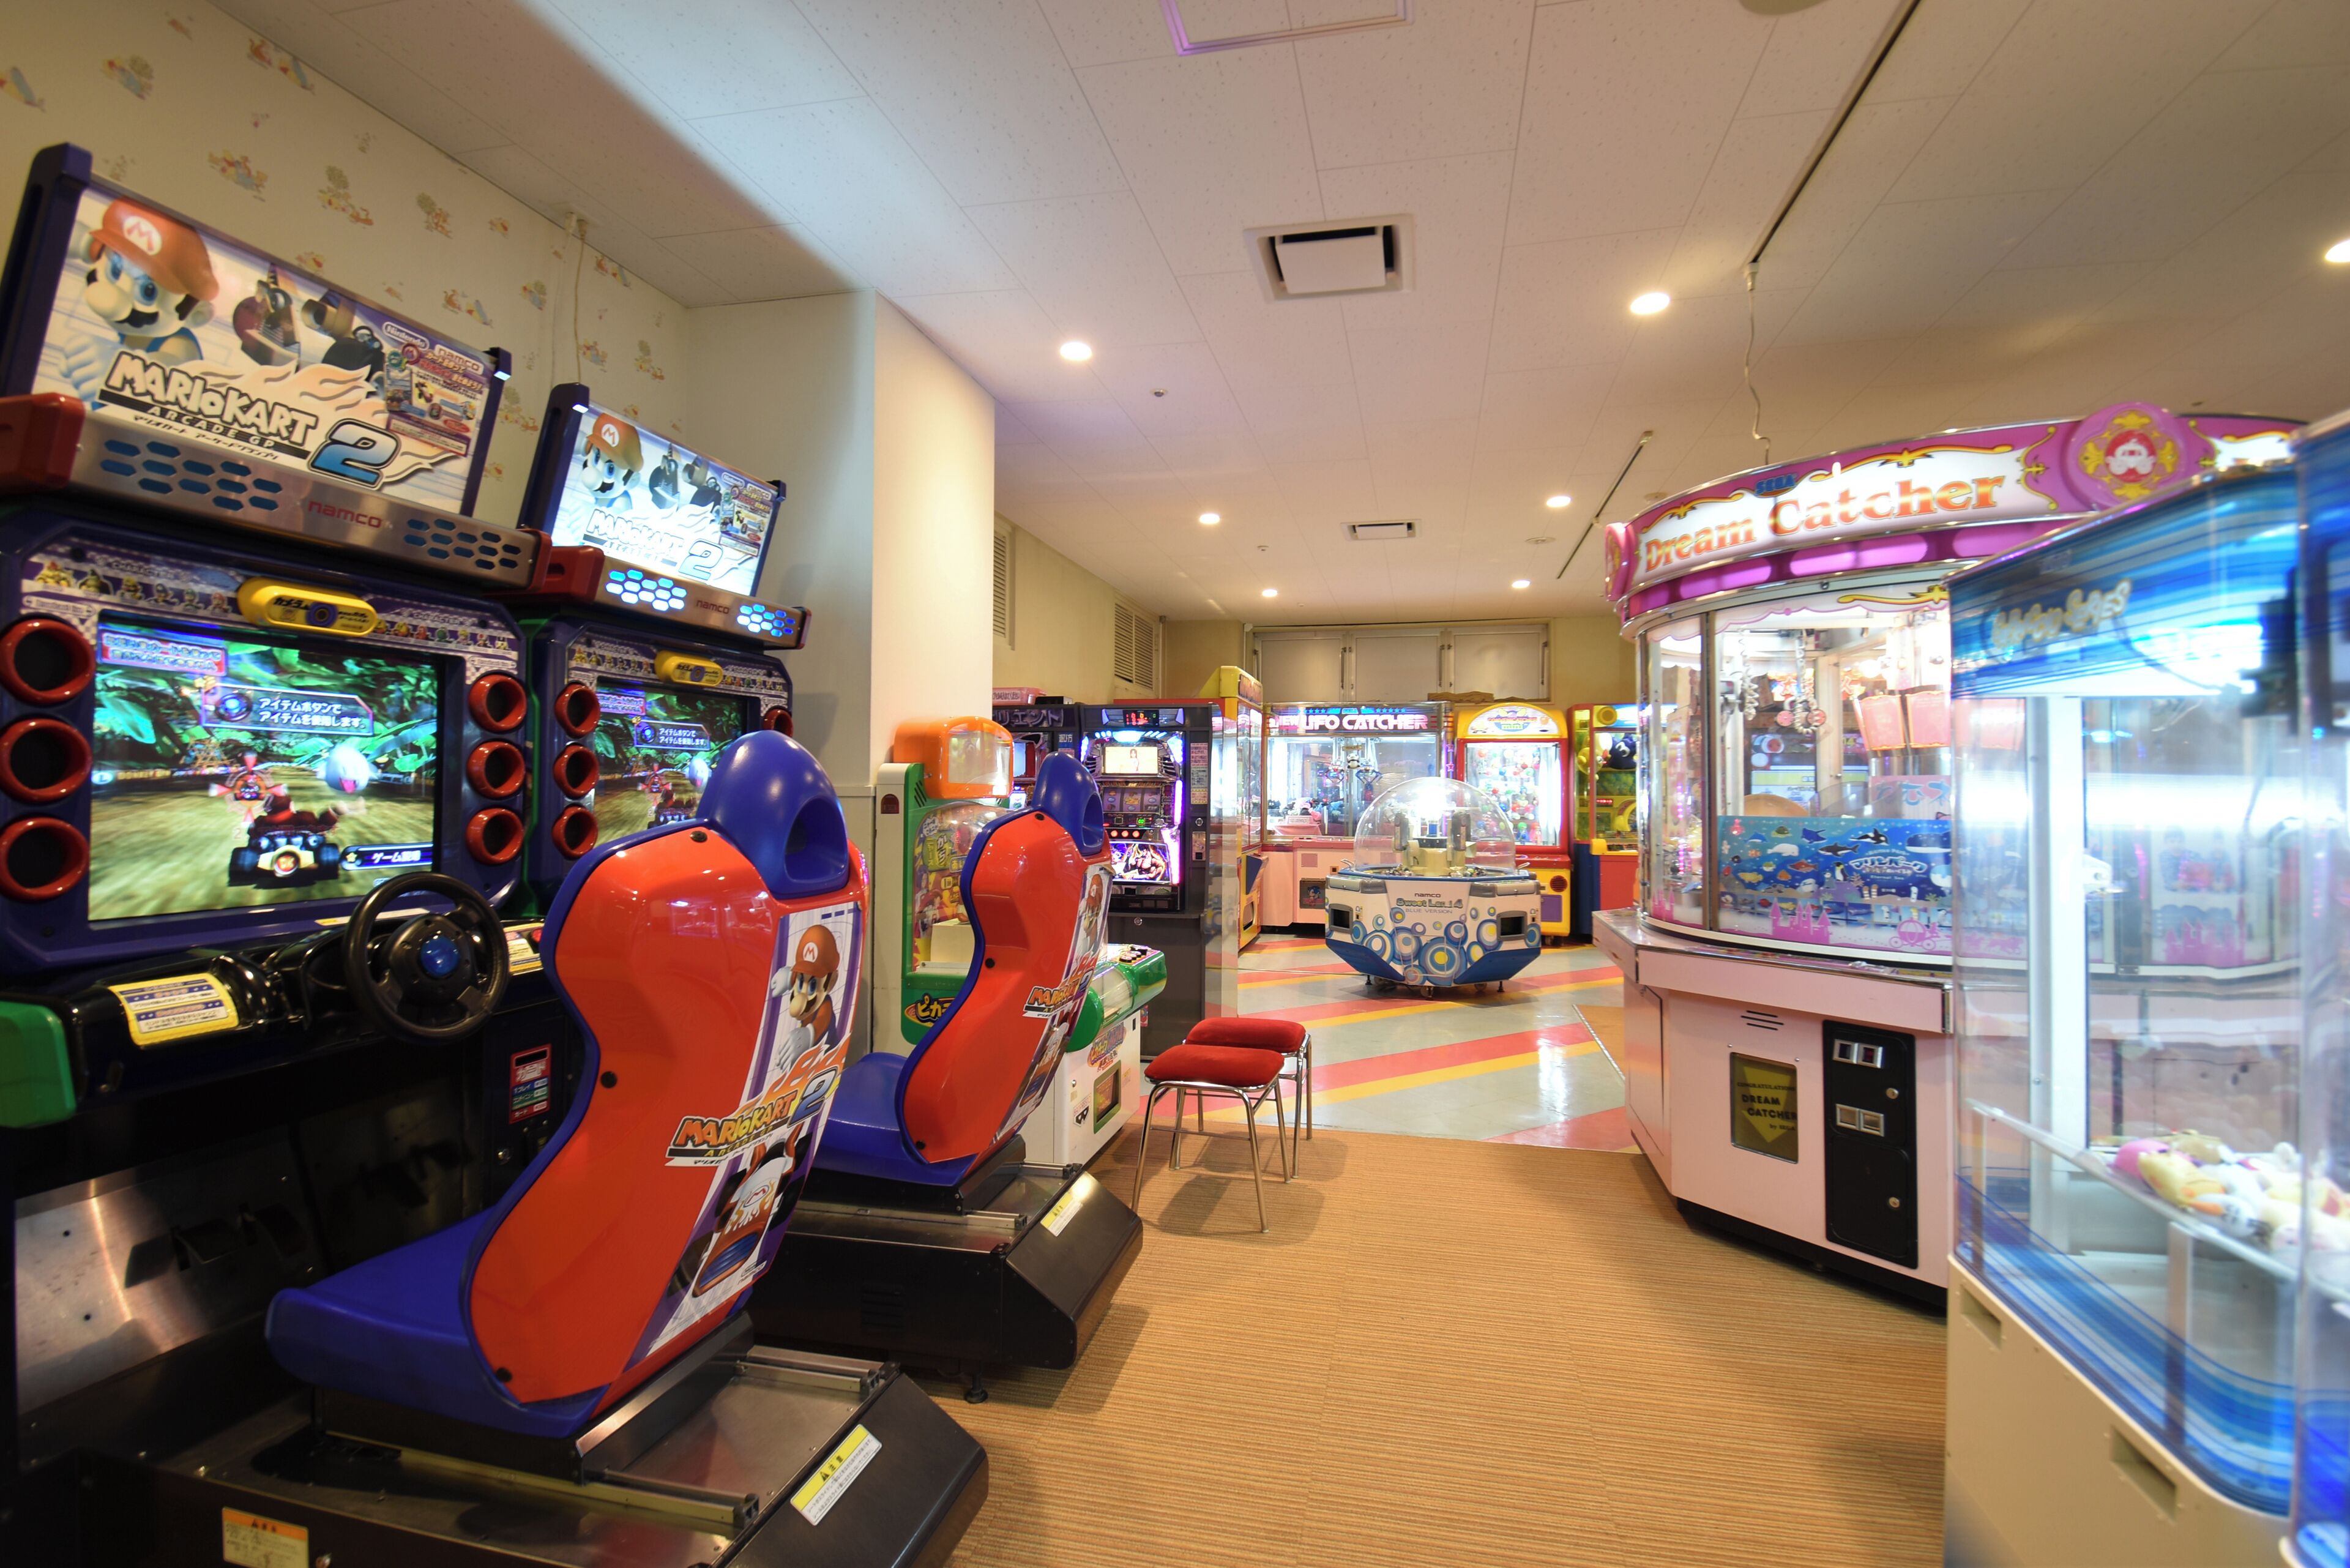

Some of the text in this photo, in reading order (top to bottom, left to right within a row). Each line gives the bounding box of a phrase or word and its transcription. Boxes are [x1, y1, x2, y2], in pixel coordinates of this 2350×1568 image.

[387, 325, 425, 346] Nintendo
[439, 348, 480, 371] namco
[147, 406, 275, 449] ARCADE GP
[309, 420, 400, 488] 2
[1755, 474, 1796, 495] SEGA
[308, 500, 381, 528] namco
[1646, 475, 2006, 572] Dream Catcher
[678, 539, 723, 580] 2
[696, 600, 729, 614] namco
[259, 698, 341, 714] アイテムボタンで
[993, 710, 1059, 725] リエント
[1304, 715, 1340, 730] UFO
[1343, 714, 1428, 730] CATCHER
[1849, 856, 1927, 873] マリンパーク
[1397, 898, 1427, 906] Sweet
[1453, 899, 1463, 908] 4
[788, 1066, 837, 1128] 2
[1737, 1082, 1796, 1092] CONGRATULATIONS
[1742, 1094, 1780, 1105] DREAM
[1747, 1107, 1797, 1120] CATCHER
[704, 1136, 754, 1157] ARCADE
